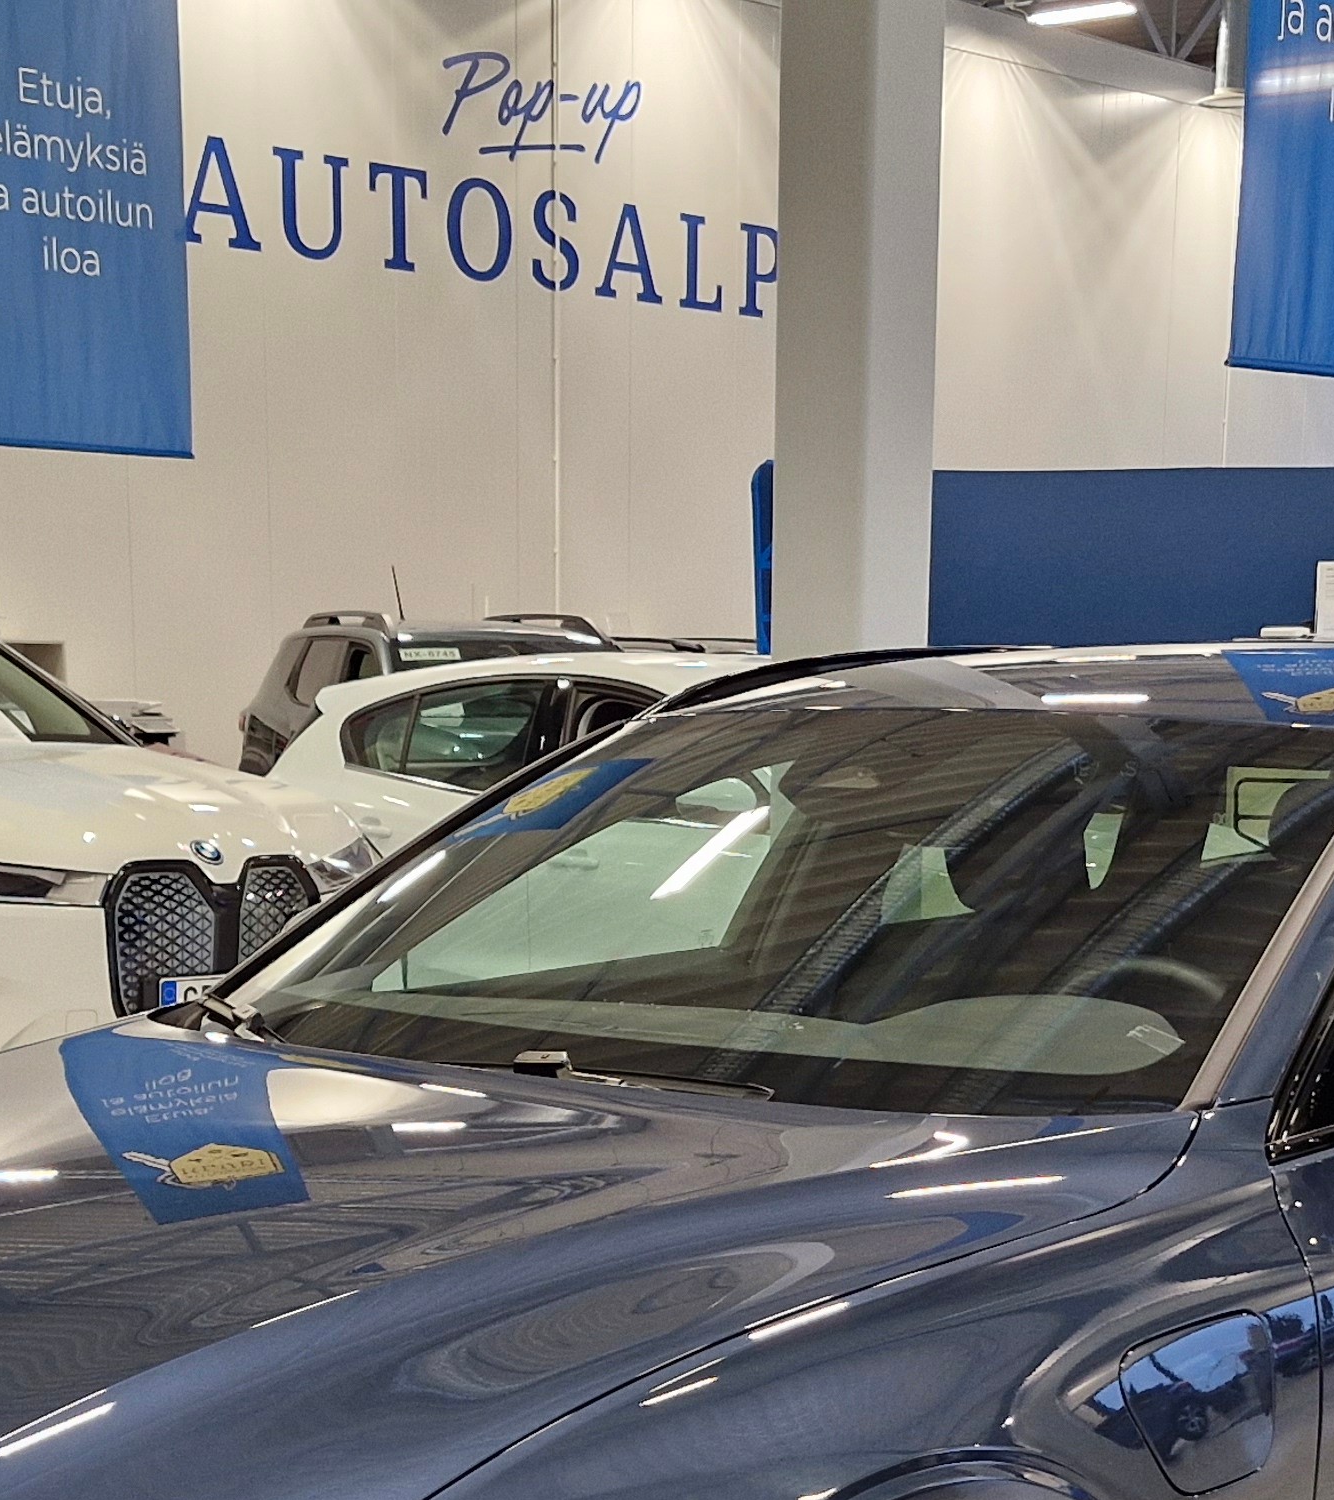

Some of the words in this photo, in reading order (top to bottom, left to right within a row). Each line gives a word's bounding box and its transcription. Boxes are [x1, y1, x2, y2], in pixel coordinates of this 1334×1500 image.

[1278, 0, 1305, 41] ja
[18, 66, 111, 120] Etuja,
[442, 51, 642, 164] Pop-up
[21, 186, 154, 230] autoilun
[43, 236, 101, 277] iloa
